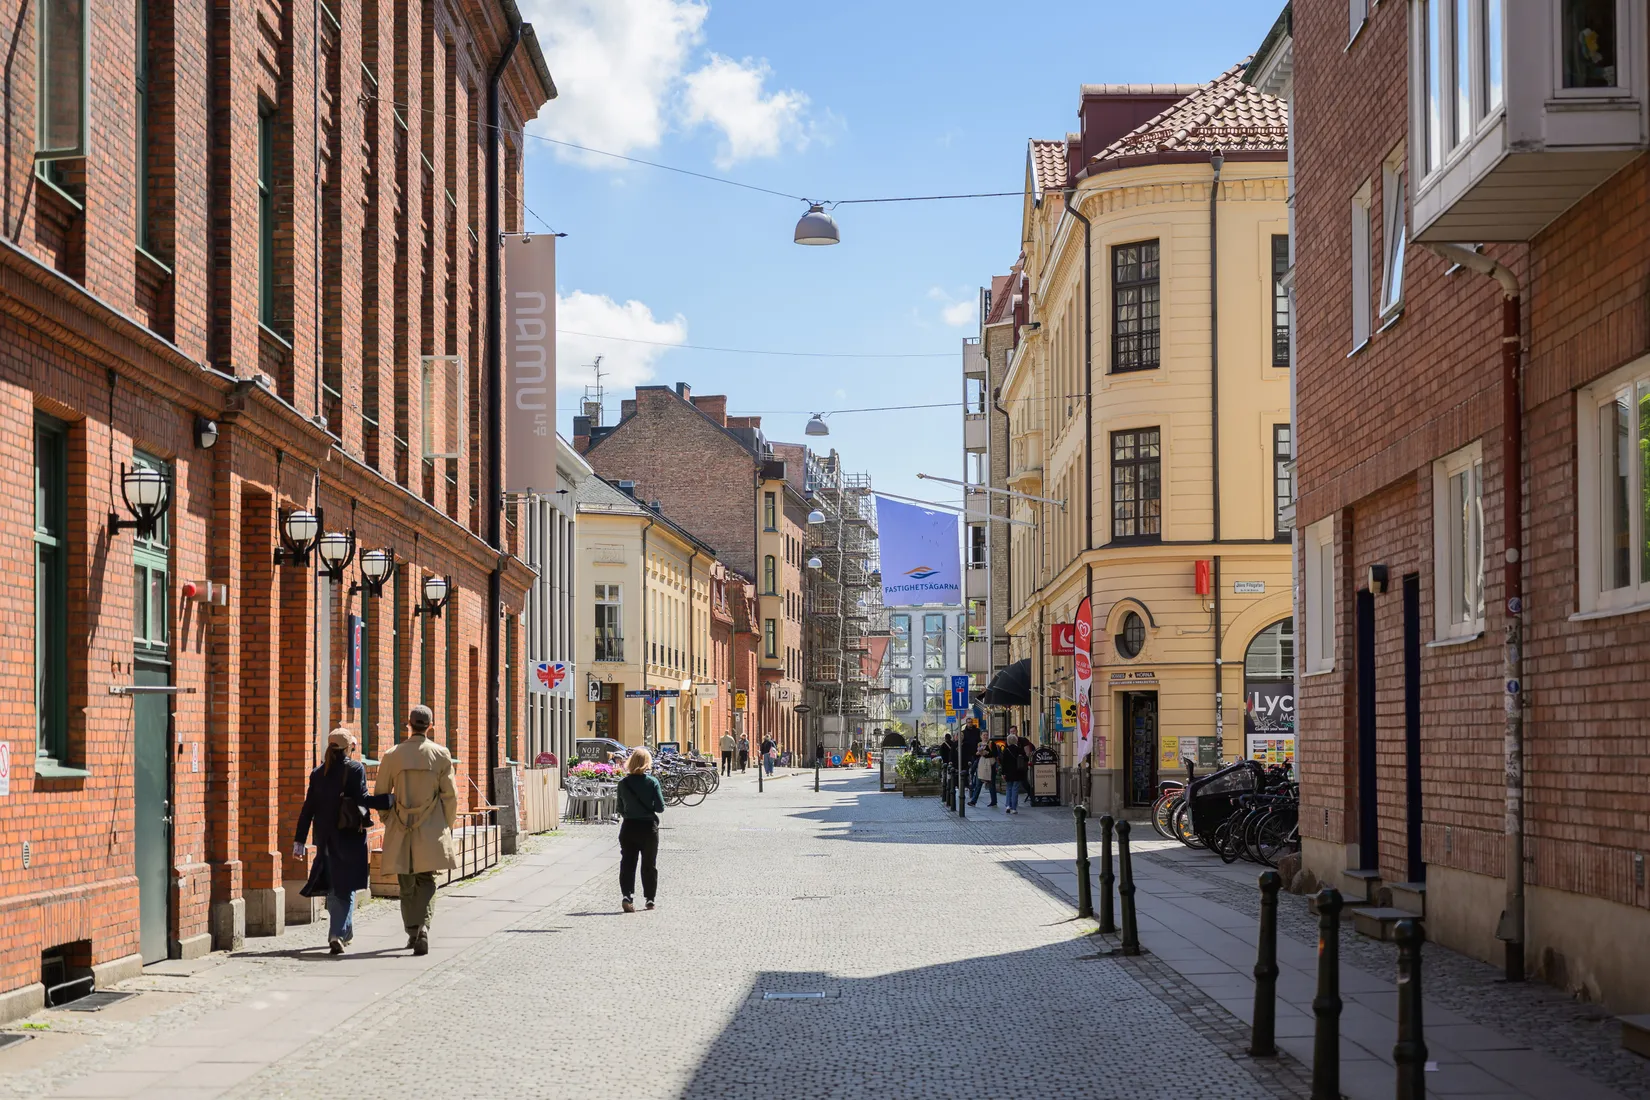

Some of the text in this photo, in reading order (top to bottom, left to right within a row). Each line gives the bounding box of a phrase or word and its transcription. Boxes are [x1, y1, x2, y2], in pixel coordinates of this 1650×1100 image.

[515, 291, 547, 411] namu
[885, 582, 959, 593] FASTIGHETSÄGARNA
[607, 673, 613, 682] 8
[778, 690, 788, 699] 12
[1254, 691, 1294, 716] Lyc
[581, 746, 601, 754] NOIR
